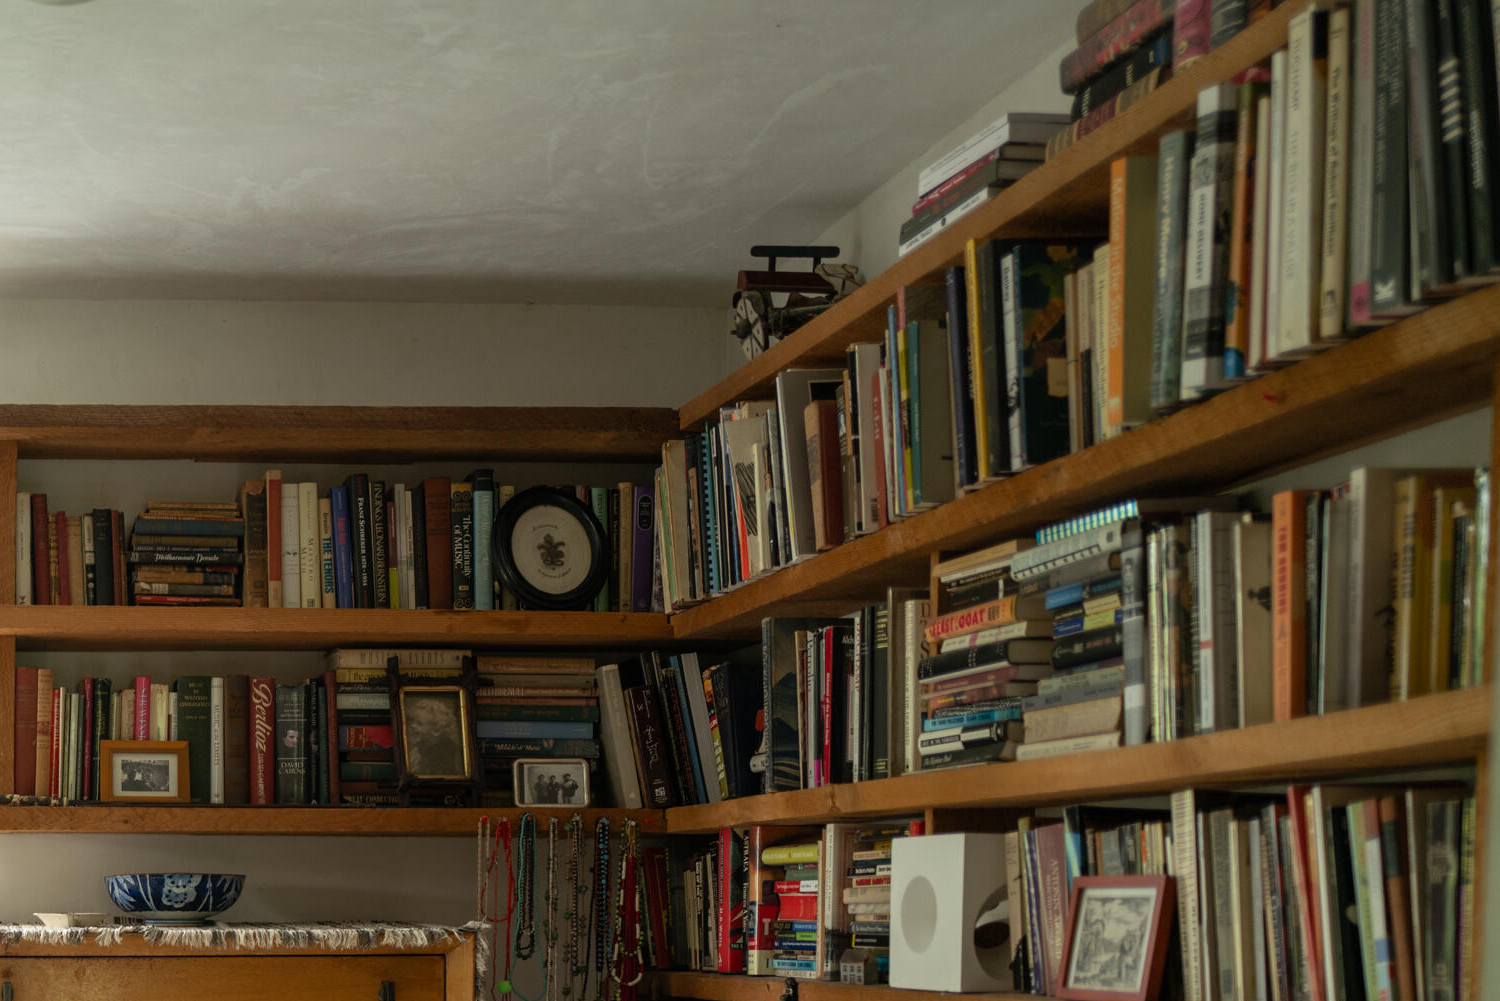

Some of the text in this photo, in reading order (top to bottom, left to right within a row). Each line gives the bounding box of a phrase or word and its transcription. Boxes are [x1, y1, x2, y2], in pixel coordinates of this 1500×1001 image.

[1160, 155, 1176, 213] Henry
[1111, 177, 1124, 246] Matisse
[1158, 215, 1172, 279] Moore
[1110, 263, 1122, 289] the
[1109, 290, 1121, 349] Studio
[154, 553, 196, 562] Philharmonic
[323, 536, 332, 555] THE
[454, 536, 463, 569] MUSIC
[461, 533, 473, 577] Continuity
[323, 557, 334, 594] TENORS
[958, 608, 986, 629] GOAT
[251, 678, 273, 753] Berlioz
